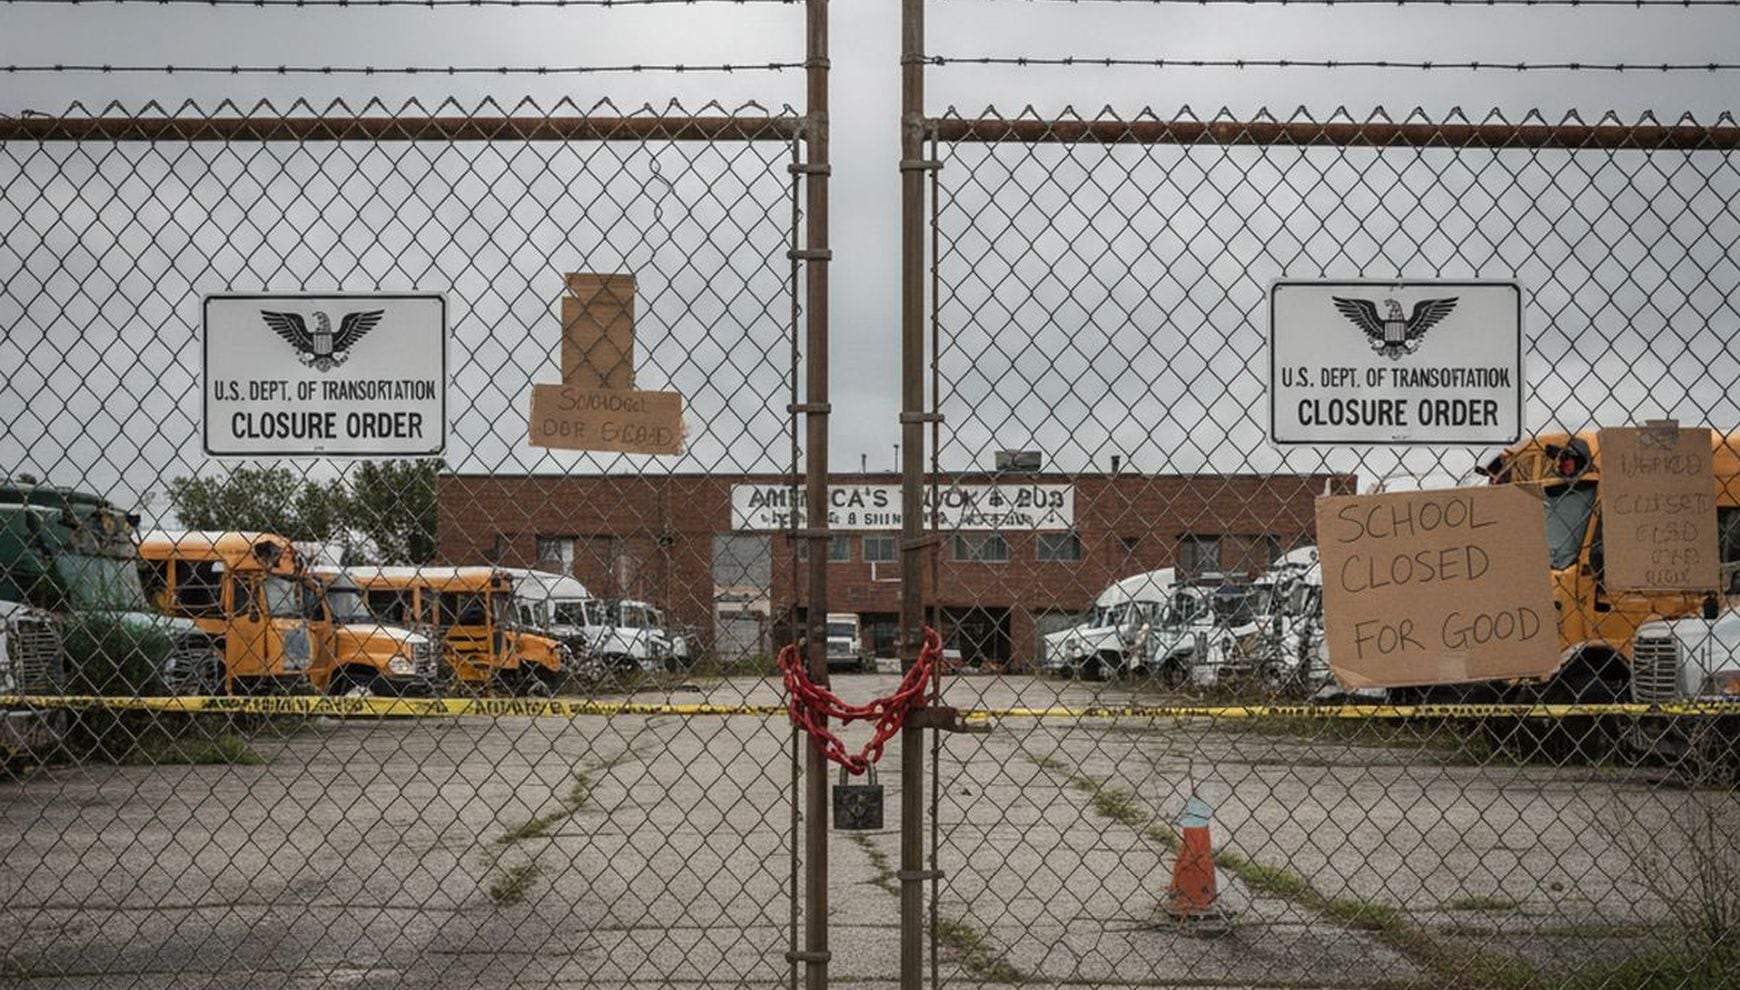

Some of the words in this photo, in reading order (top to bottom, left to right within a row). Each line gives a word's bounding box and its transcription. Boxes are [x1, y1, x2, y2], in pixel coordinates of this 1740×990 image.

[214, 380, 246, 401] U.S.
[249, 380, 292, 401] DEPT.
[297, 380, 317, 401] OF
[1282, 367, 1315, 388] U.S.
[1321, 367, 1361, 388] DEPT.
[1366, 367, 1387, 388] OF
[231, 411, 337, 439] CLOSURE
[346, 411, 423, 439] ORDER
[1298, 399, 1408, 426] CLOSURE
[1418, 399, 1498, 426] ORDER
[1338, 497, 1497, 543] SCHOOL
[1341, 545, 1490, 593] CLOSED
[1355, 618, 1426, 659] FOR
[1442, 607, 1541, 650] GOOD
